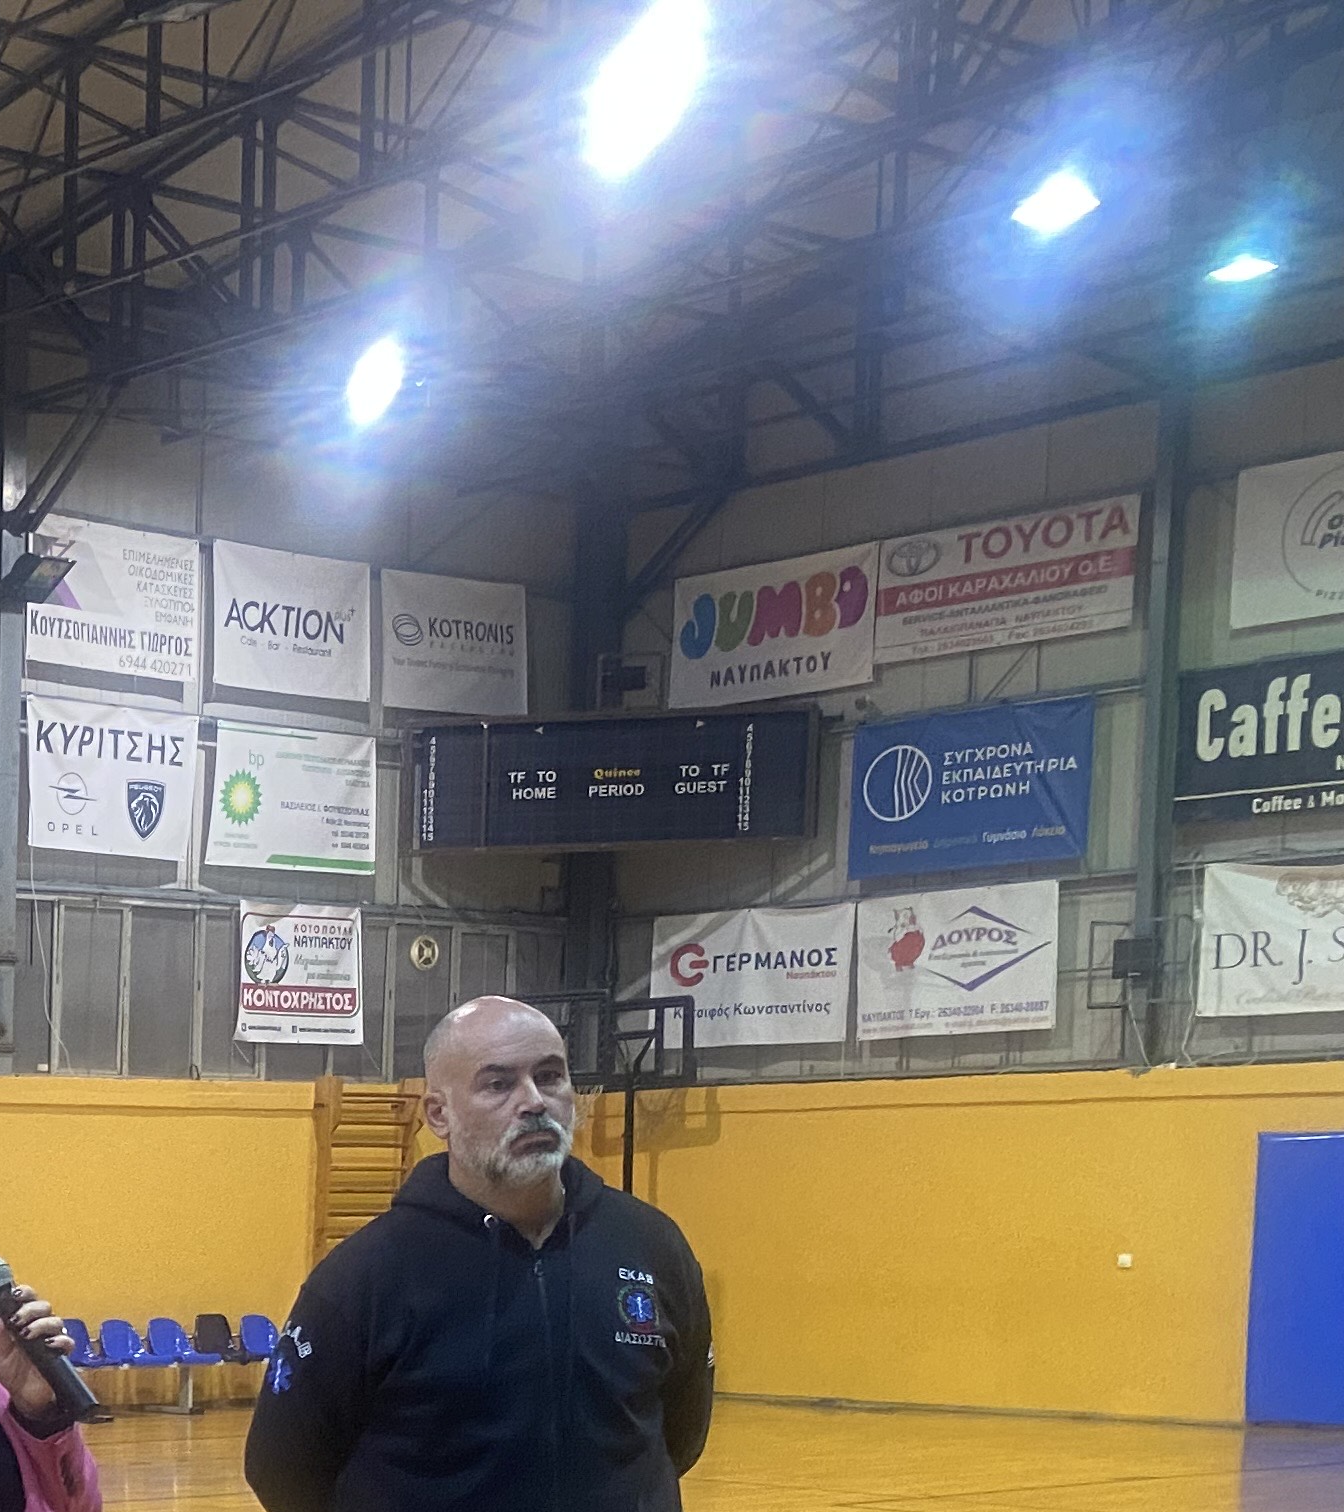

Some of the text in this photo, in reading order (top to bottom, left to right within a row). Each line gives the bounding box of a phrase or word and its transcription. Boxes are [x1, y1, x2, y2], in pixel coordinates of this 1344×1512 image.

[957, 503, 1130, 565] TOYOTA
[122, 549, 195, 573] ΕΠΙΜΕΛΗΜΕΝΕΣ
[128, 564, 194, 586] ΟΙΚΟΔΟΜΙΚΕΣ
[895, 586, 944, 607] ΑΦΟΙ
[949, 563, 1074, 597] ΚΑΡΑΧΑΛΙΟΥ
[136, 580, 194, 600] ΚΑΤΑΣΚΕΥΕΣ
[223, 598, 344, 645] ACKTION
[680, 565, 869, 660] JUMBO
[30, 609, 193, 657] ΚΟΥΤΣΟΓΙΑΝΝΗΣ ΓΙΩΡΓΟΣ
[428, 617, 514, 645] KOTRONIS
[119, 655, 191, 677] 6944 420271
[710, 651, 832, 689] ΝΑΥΠΑΚΤΟΥ
[36, 720, 184, 767] ΚΥΡΙΤΣΗΣ
[943, 742, 1034, 766] ΣΥΓΧΡΟΝΑ
[248, 749, 265, 771] bp
[679, 763, 730, 778] TO TF
[942, 756, 1078, 785] ΕΚΠΑΙΔΕΥΤΗΡΙΑ
[508, 770, 557, 784] TF TO
[674, 780, 727, 795] GUEST
[512, 787, 557, 800] HOME
[588, 784, 645, 798] PERIOD
[941, 780, 1030, 805] ΚΟΤΡΩΝΗ
[1252, 795, 1302, 814] Coffee
[47, 821, 99, 836] OPEL
[982, 829, 1027, 844] Γυμνάσιο
[293, 935, 353, 951] ΝΑΥΠΑΚΤΟΥ
[931, 927, 1018, 950] ΔΟΥΡΟΣ
[713, 947, 838, 974] ΓΕΡΜΑΝΟΣ
[1291, 929, 1313, 985] J.
[243, 988, 353, 1011] ΚΟΝΤΟΧΡΗΣΤΟΣ
[733, 1000, 831, 1016] Κωνσταντίνος
[618, 1267, 654, 1285] ΕΚΑΒ
